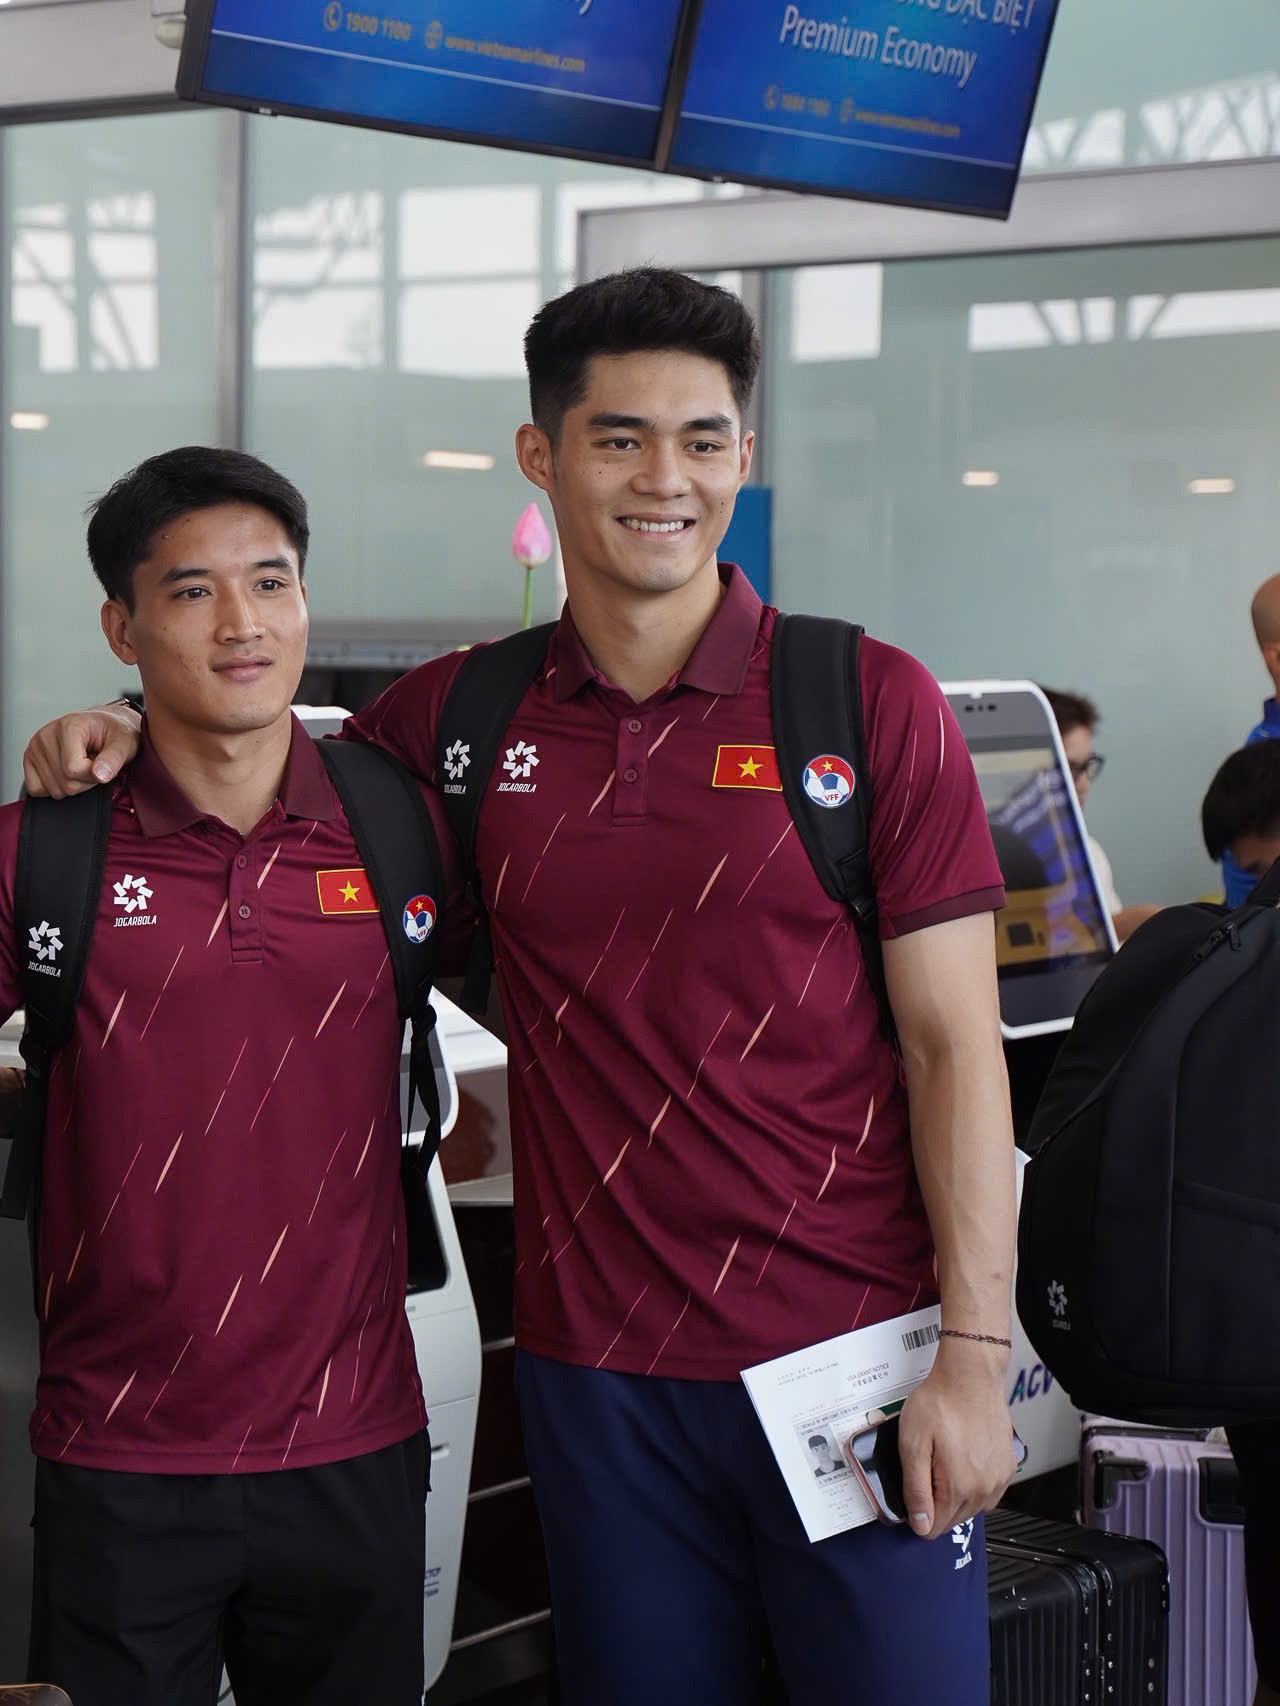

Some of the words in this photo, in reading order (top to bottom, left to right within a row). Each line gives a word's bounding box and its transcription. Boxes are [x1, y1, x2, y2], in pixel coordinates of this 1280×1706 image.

[780, 5, 878, 59] Premium
[881, 26, 977, 88] Economy
[496, 782, 537, 793] JOGARBOLA
[824, 793, 840, 801] VFF
[113, 915, 157, 928] JOGARBOLA
